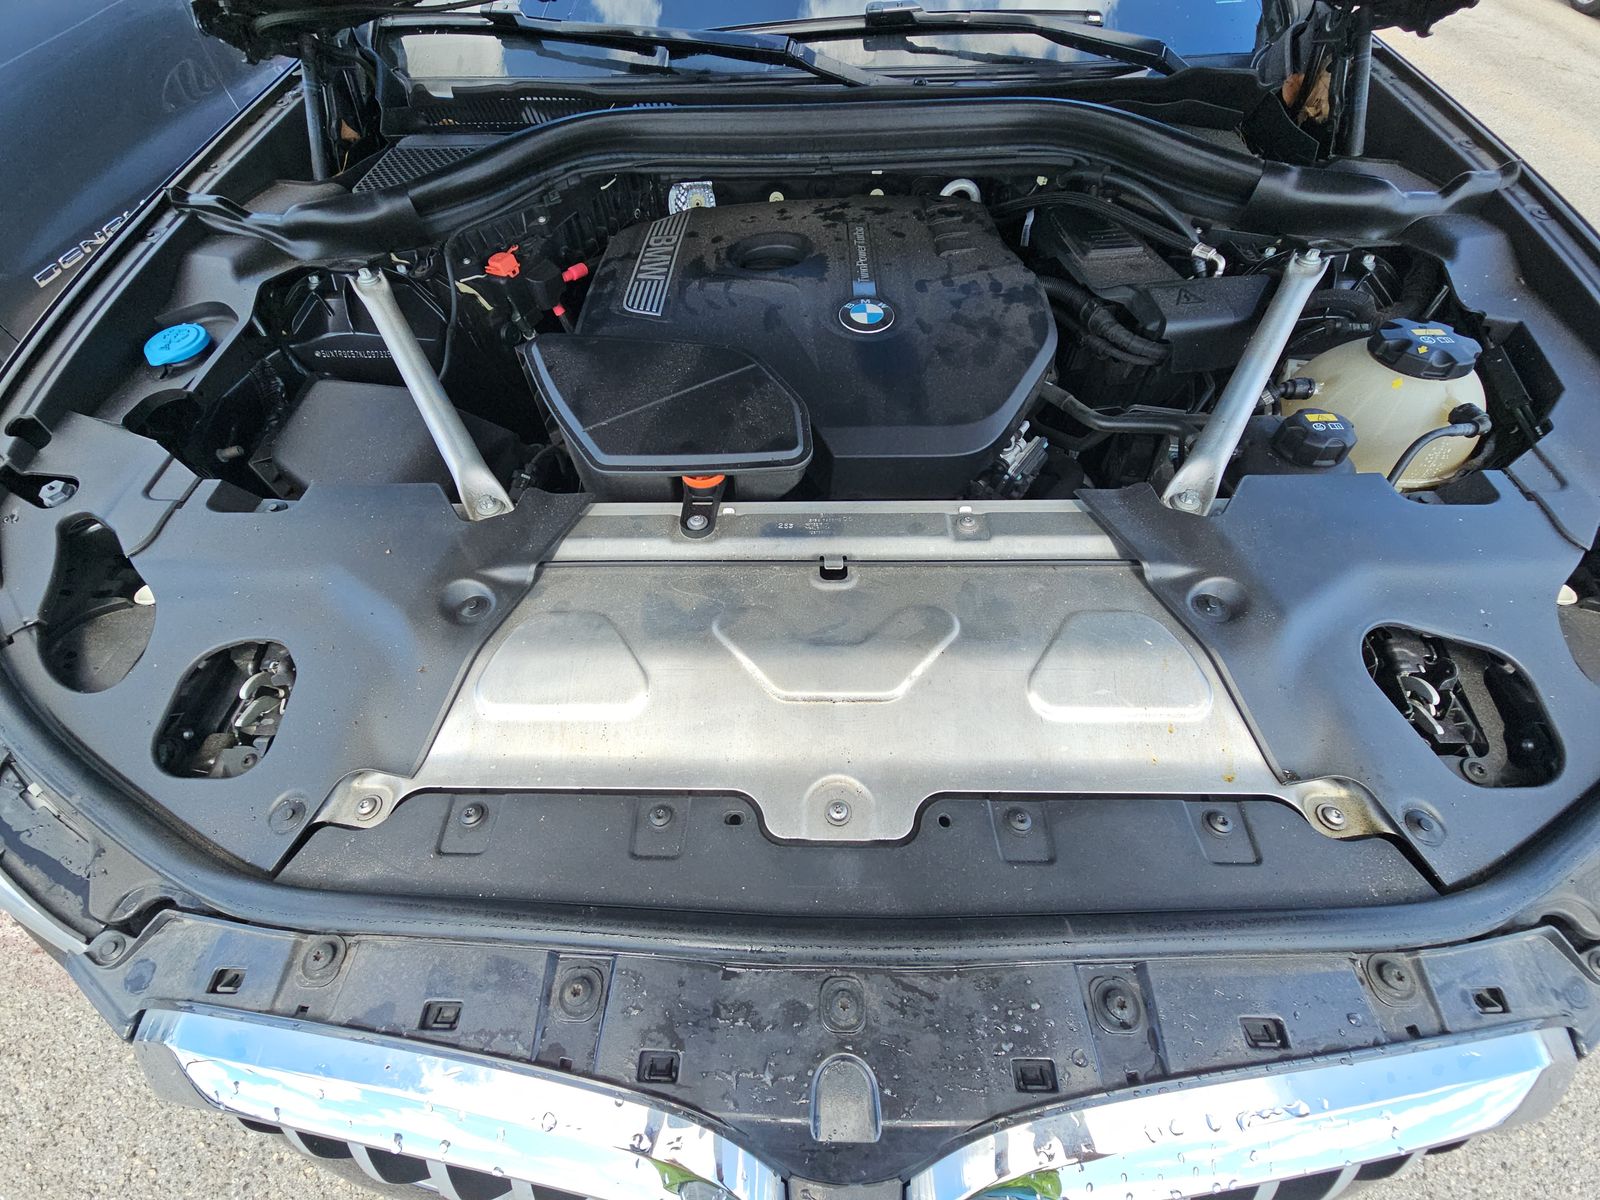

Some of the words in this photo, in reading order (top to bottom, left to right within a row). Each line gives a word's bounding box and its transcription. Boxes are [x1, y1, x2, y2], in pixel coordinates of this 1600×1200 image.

[33, 199, 145, 288] DENA
[636, 234, 678, 280] BMW
[844, 298, 889, 309] BMW
